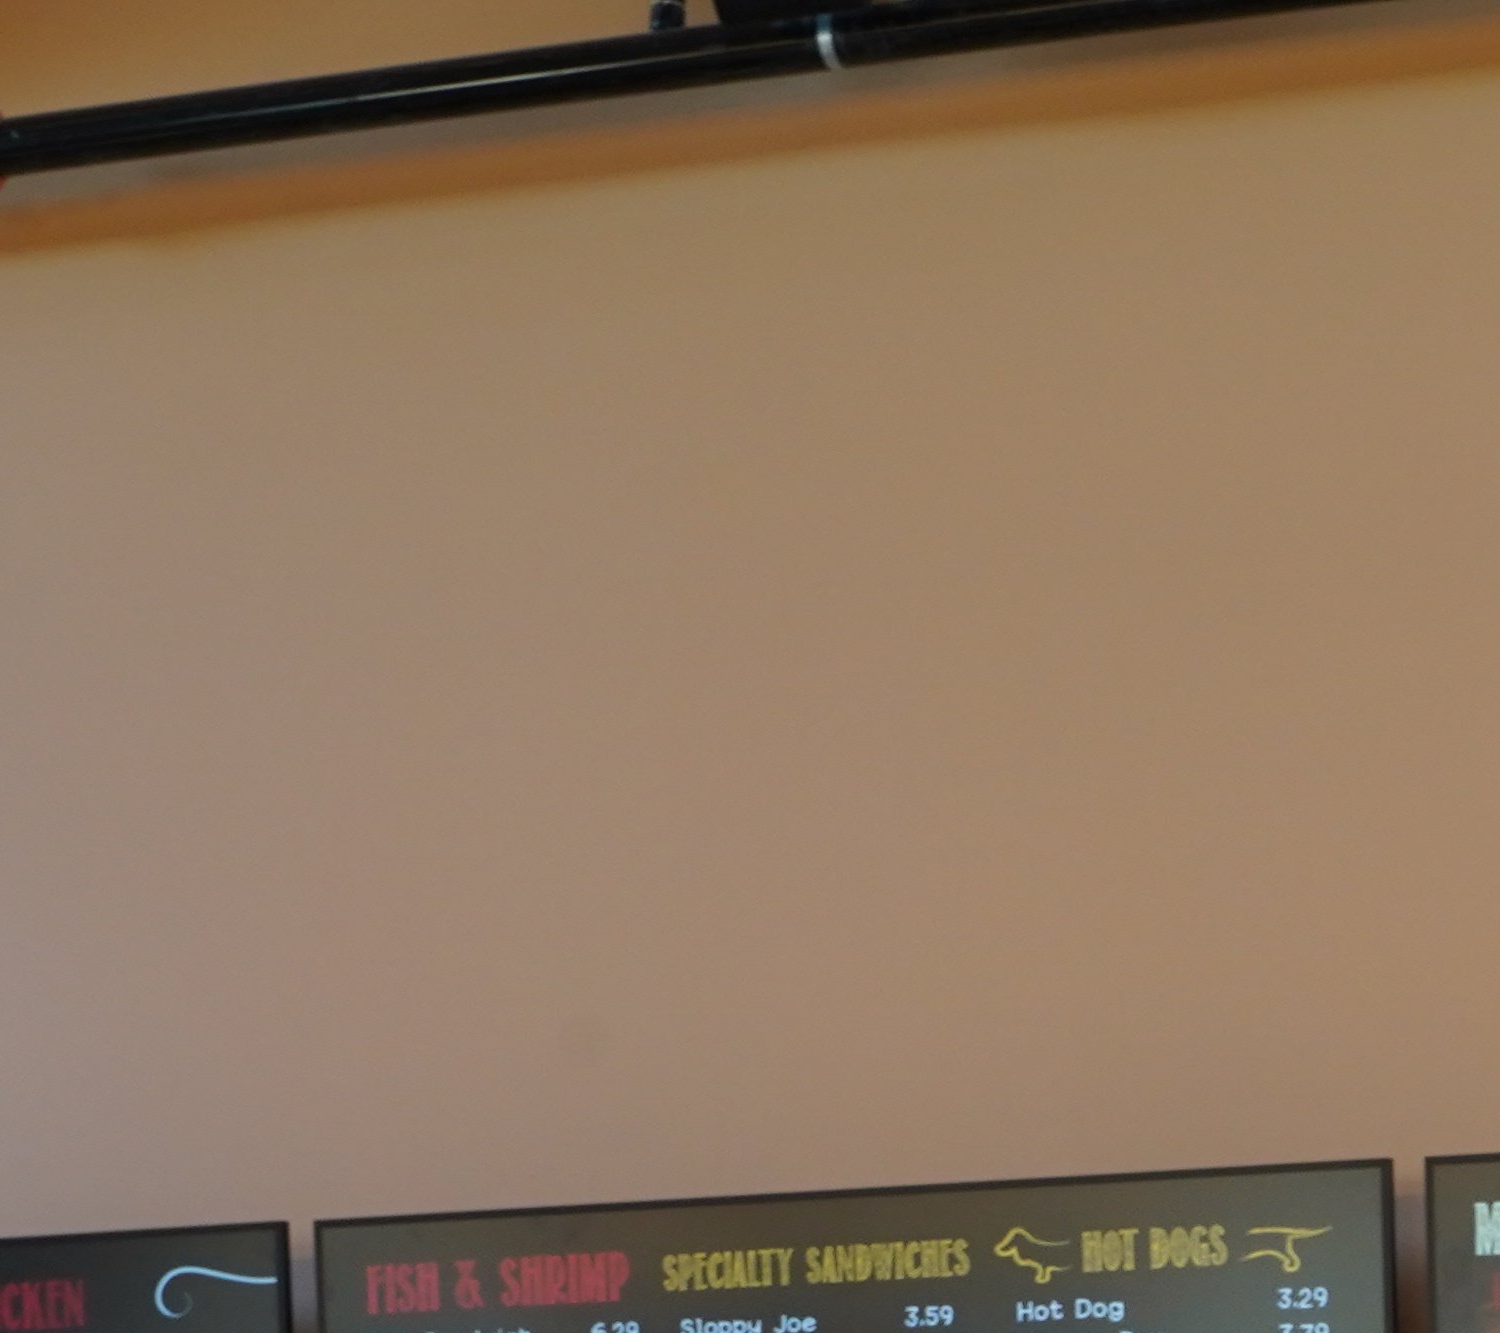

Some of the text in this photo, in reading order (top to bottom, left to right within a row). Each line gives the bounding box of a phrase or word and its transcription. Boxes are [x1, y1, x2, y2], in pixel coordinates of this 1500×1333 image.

[1081, 1224, 1228, 1272] HOT DOGS
[662, 1238, 970, 1291] SPECIALTY SANDWICHES
[366, 1251, 630, 1314] FISH & SHRIMP
[1017, 1298, 1125, 1322] Hot Dog
[1277, 1287, 1328, 1309] 3.29
[774, 1315, 817, 1333] Joe
[905, 1305, 954, 1328] 3.59
